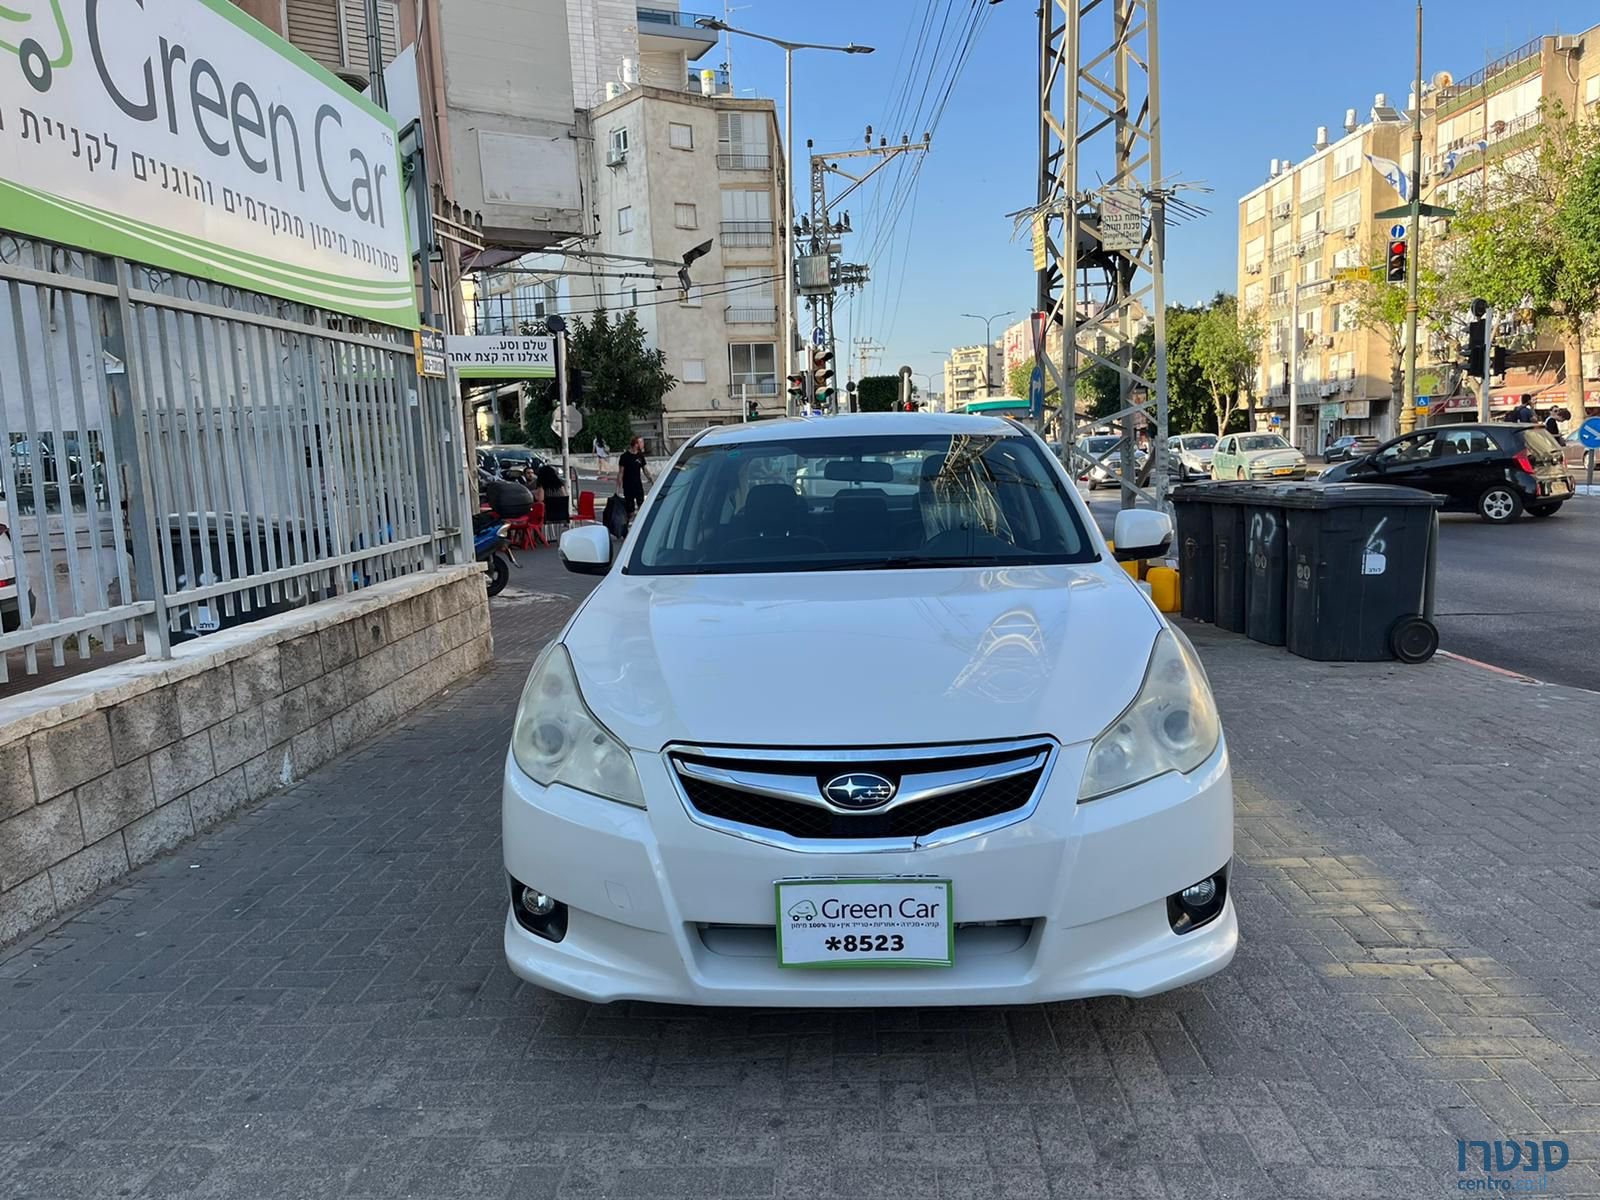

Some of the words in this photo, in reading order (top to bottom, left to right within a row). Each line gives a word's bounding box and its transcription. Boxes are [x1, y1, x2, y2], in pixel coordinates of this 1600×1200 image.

[85, 0, 305, 193] Green
[314, 104, 387, 229] Car
[19, 107, 118, 172] לקניית
[131, 151, 214, 206] והוגנים
[222, 186, 304, 239] מתקדמים
[309, 221, 348, 250] מימון
[352, 239, 399, 273] פתרונות
[474, 352, 499, 364] קצת
[502, 352, 515, 362] זה
[519, 351, 548, 362] אצלנו
[522, 340, 547, 350] שלם
[821, 898, 893, 920] Green
[898, 897, 940, 919] Car
[924, 921, 940, 929] קניה
